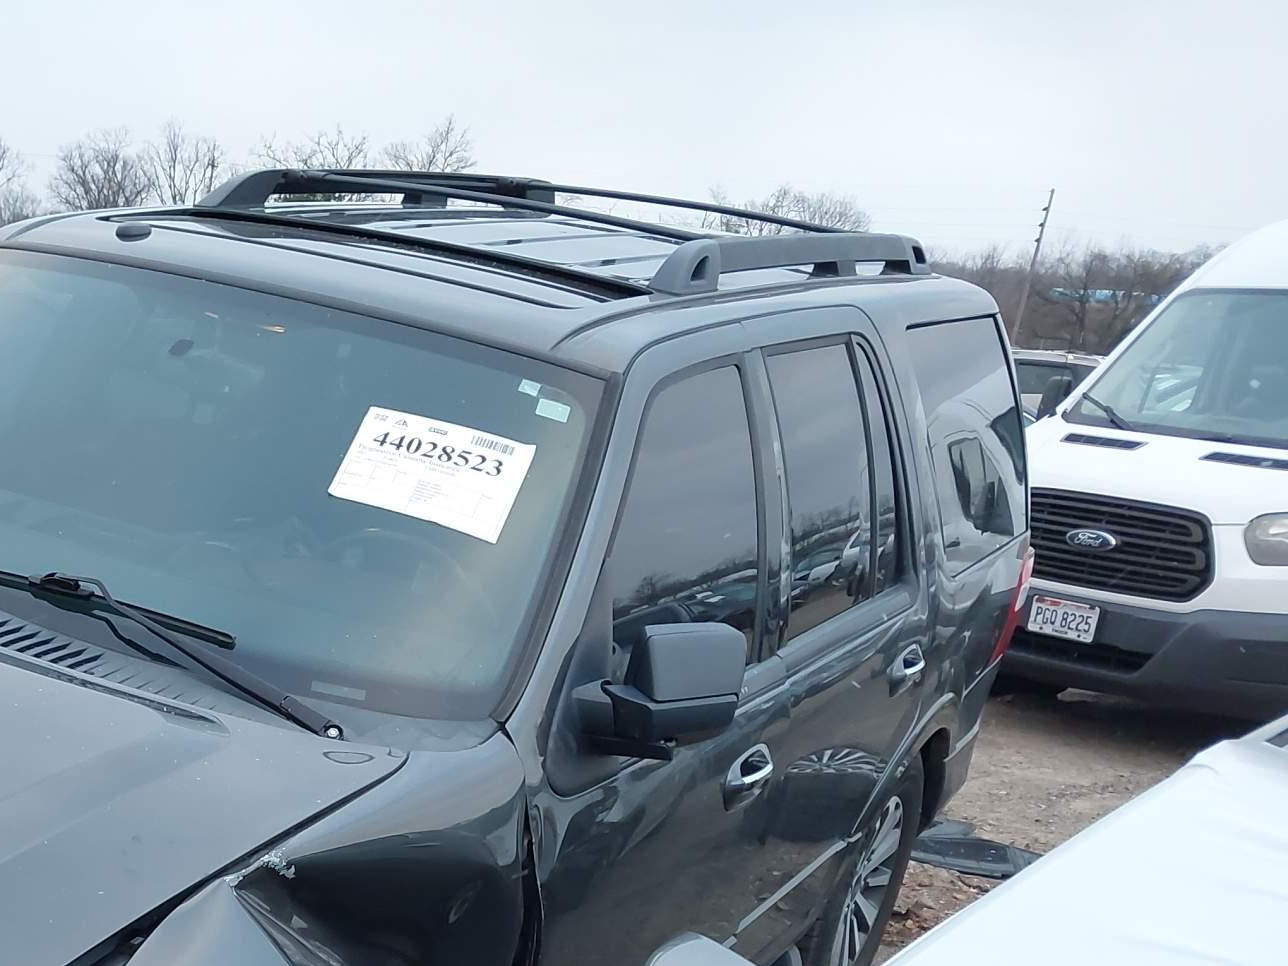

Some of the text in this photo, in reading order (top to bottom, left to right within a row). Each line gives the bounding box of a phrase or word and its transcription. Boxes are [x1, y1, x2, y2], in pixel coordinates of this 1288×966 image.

[373, 431, 503, 477] 44028523
[1075, 532, 1103, 546] Ford
[1060, 611, 1092, 633] 8225
